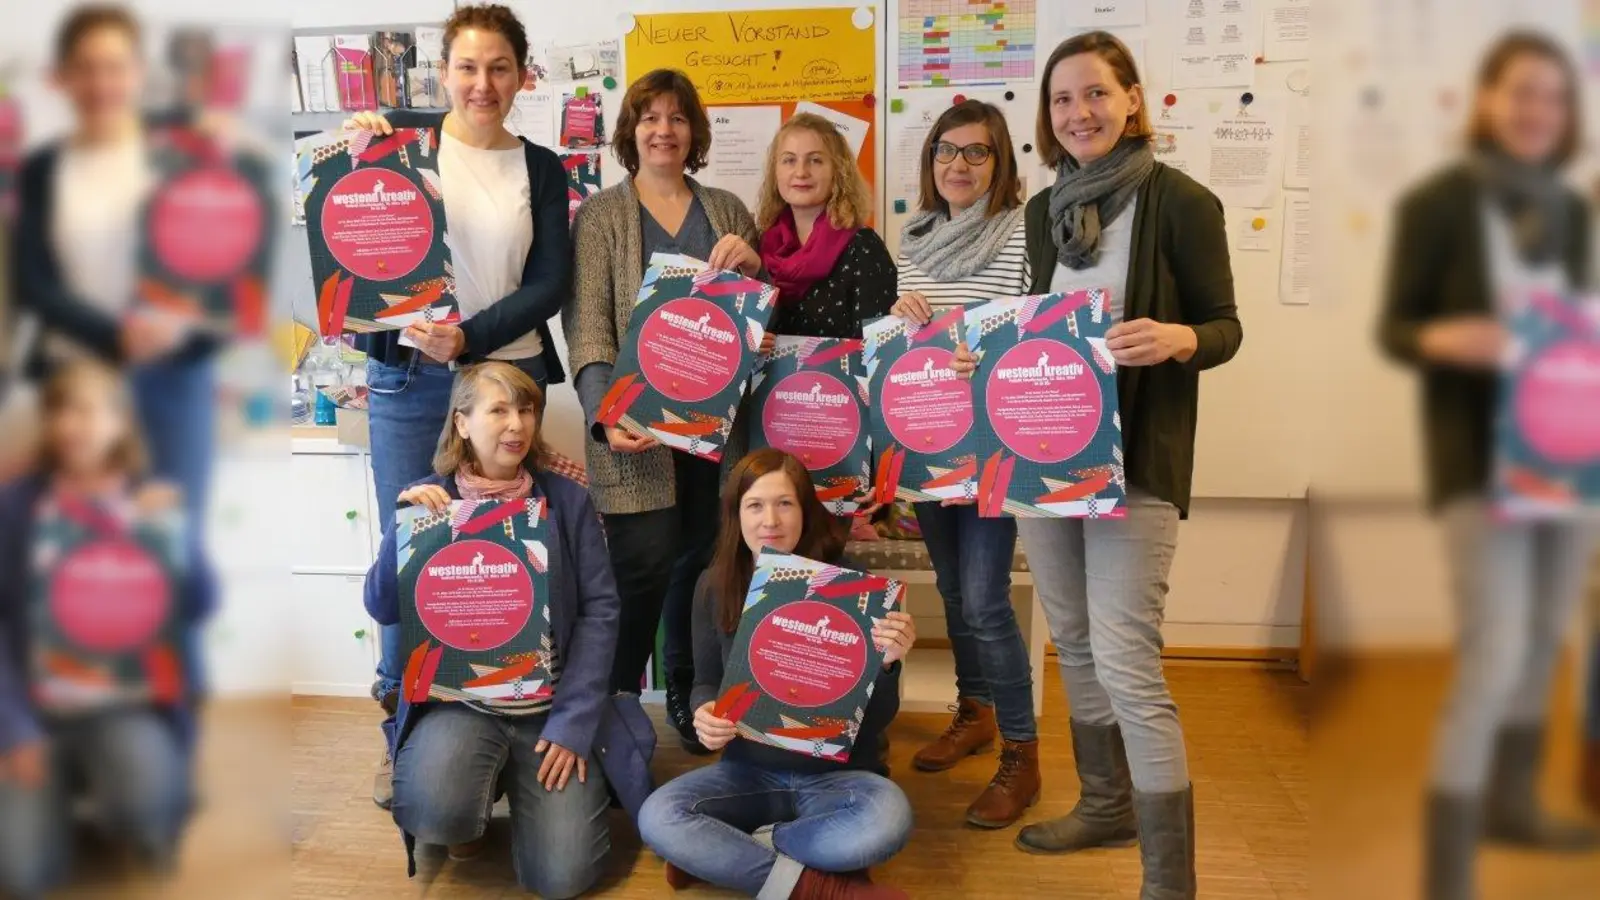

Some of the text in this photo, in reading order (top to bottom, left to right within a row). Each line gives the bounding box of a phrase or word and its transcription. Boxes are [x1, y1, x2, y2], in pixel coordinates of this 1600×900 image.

[637, 14, 830, 46] NEUER VORSTAND
[333, 190, 416, 205] westend kreativ
[660, 310, 700, 331] westend
[701, 323, 735, 343] kreativ
[890, 370, 928, 383] westend
[997, 364, 1083, 380] westend kreativ
[775, 391, 814, 403] westend
[816, 393, 849, 404] kreativ
[428, 562, 518, 577] westend kreativ
[772, 615, 818, 634] westend
[821, 627, 860, 645] kreativ
